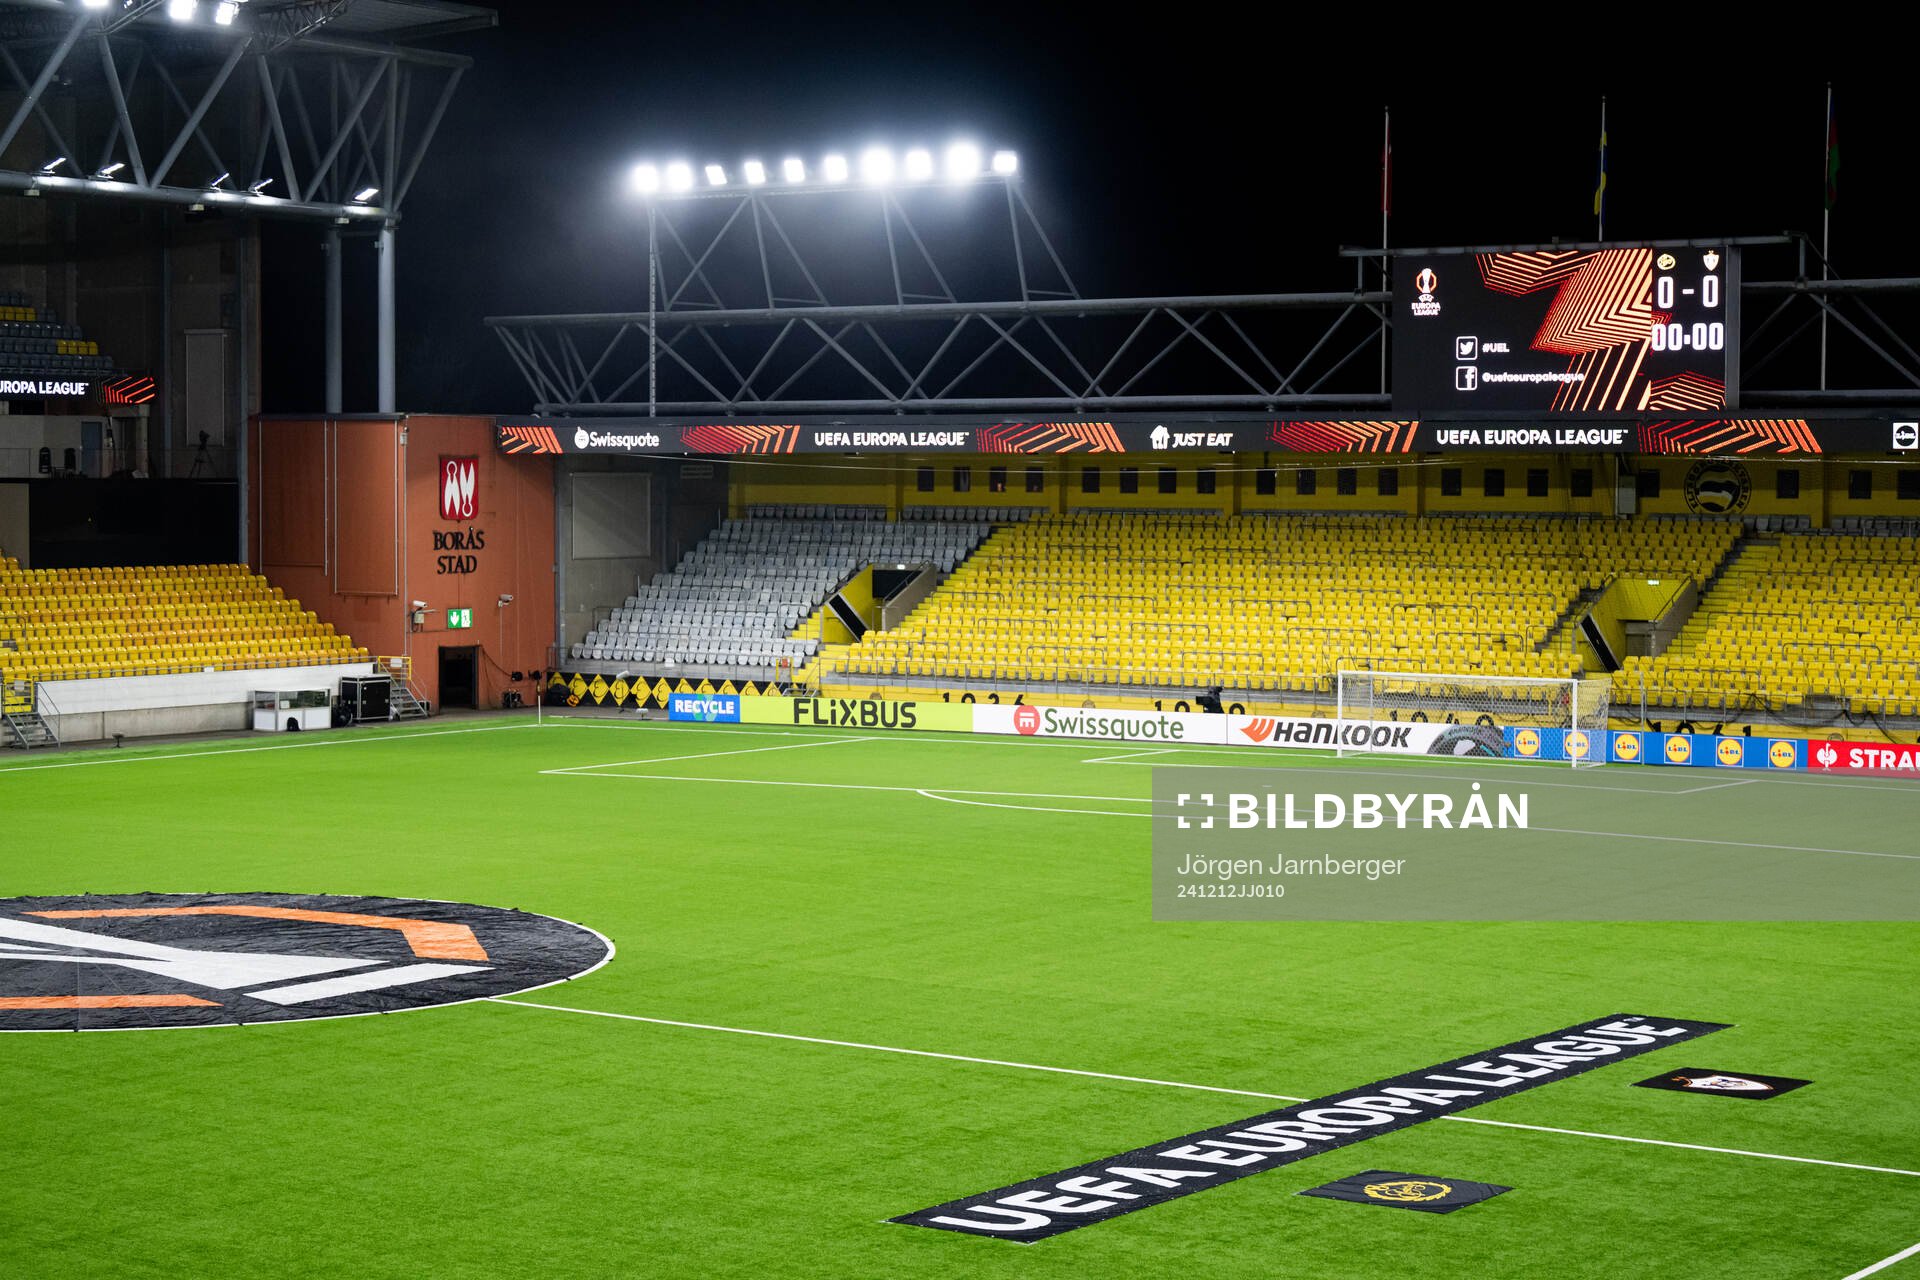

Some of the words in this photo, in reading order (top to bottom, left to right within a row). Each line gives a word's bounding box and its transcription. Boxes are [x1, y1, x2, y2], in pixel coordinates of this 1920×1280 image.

[1658, 276, 1674, 309] 0
[1703, 274, 1719, 308] 0
[1482, 342, 1510, 353] #UEL
[1482, 371, 1585, 384] @uefaeuropaleague
[590, 431, 660, 450] Swissquote
[814, 432, 851, 446] UEFA
[853, 432, 908, 446] EUROPA
[1172, 432, 1206, 448] JUST
[1206, 432, 1233, 447] EAT
[1436, 429, 1481, 445] UEFA
[1484, 429, 1552, 445] EUROPA
[432, 526, 485, 550] BORÅS
[437, 554, 478, 575] STAD
[674, 699, 735, 715] RECYCLE
[1044, 707, 1184, 740] Swissquote
[929, 1165, 1218, 1232] UEFA
[1157, 1086, 1484, 1167] EUROPA
